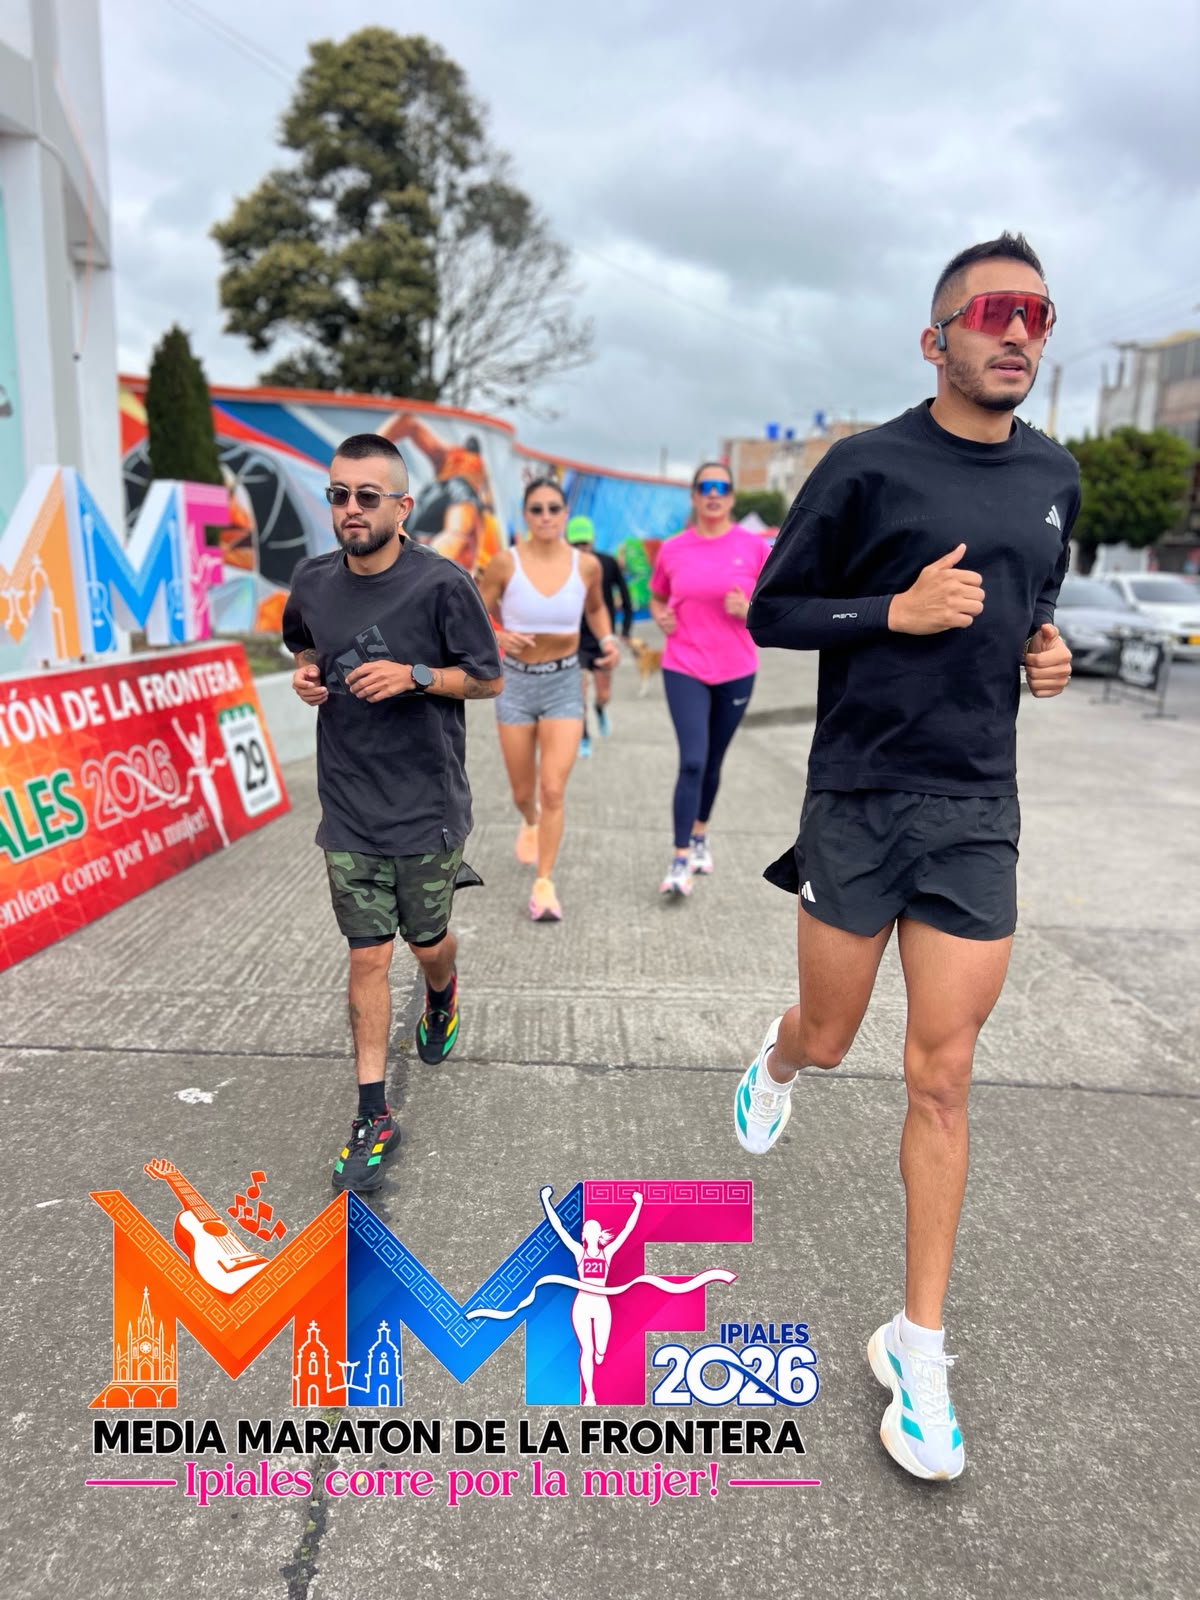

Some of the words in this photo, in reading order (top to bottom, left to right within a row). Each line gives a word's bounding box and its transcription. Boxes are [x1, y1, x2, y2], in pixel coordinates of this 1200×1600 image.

[61, 686, 105, 731] DE
[102, 679, 142, 721] LA
[138, 659, 243, 712] FRONTERA
[81, 738, 181, 830] 2026
[235, 738, 269, 792] 29
[62, 855, 113, 895] corre
[112, 840, 144, 879] por
[142, 829, 164, 856] la
